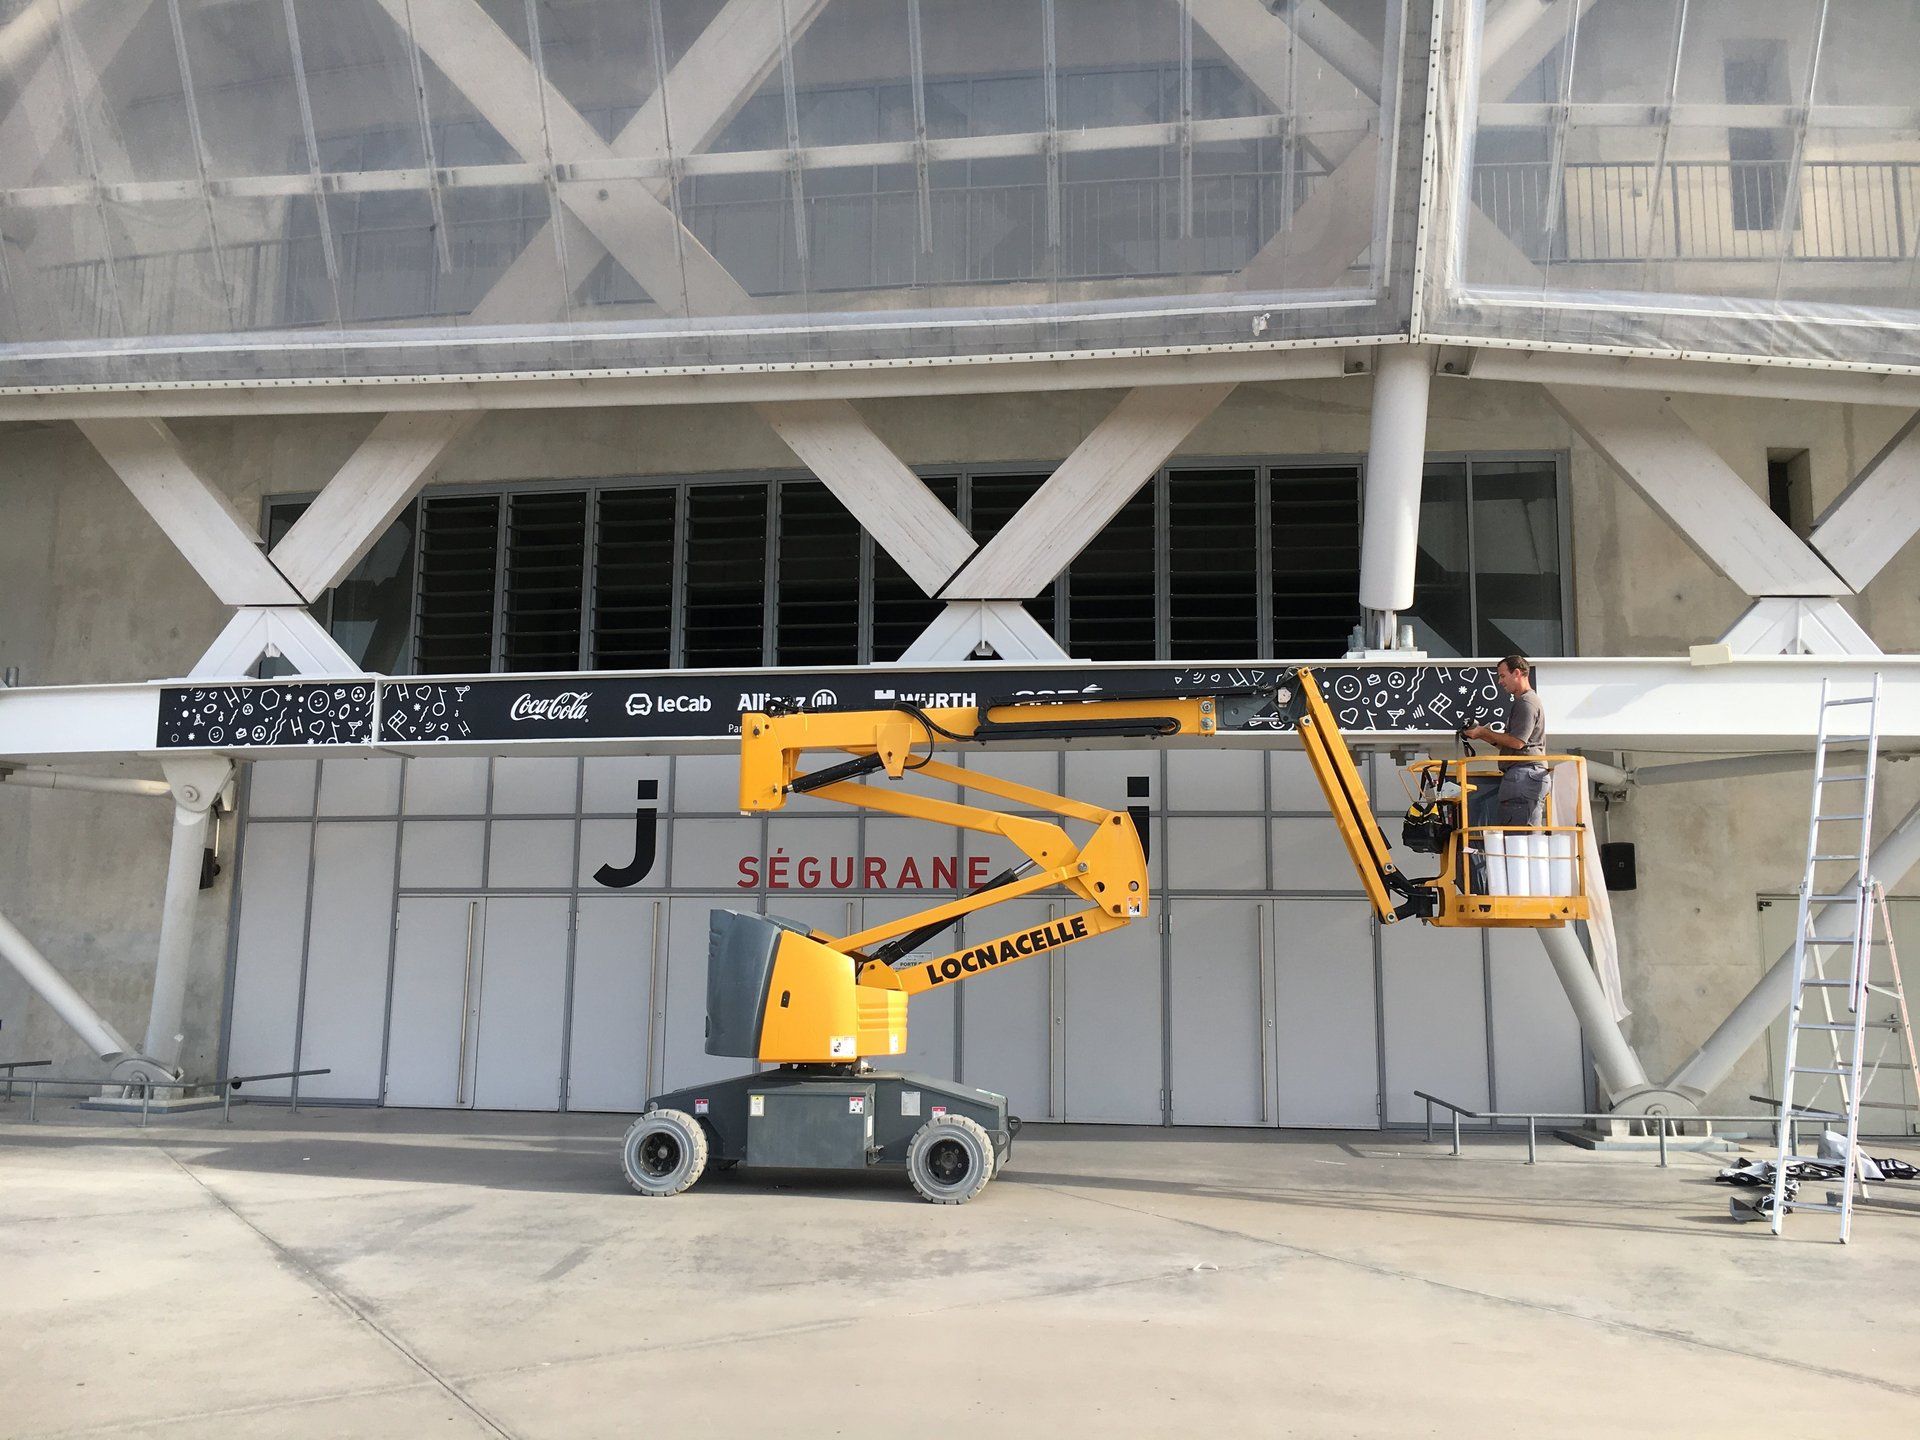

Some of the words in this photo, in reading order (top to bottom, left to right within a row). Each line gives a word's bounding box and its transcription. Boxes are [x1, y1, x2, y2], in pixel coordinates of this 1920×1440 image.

[510, 692, 593, 721] Coca-Cola
[657, 695, 712, 713] leCab
[737, 848, 990, 888] SÉGURANE
[926, 916, 1088, 985] LOCNACELLE
